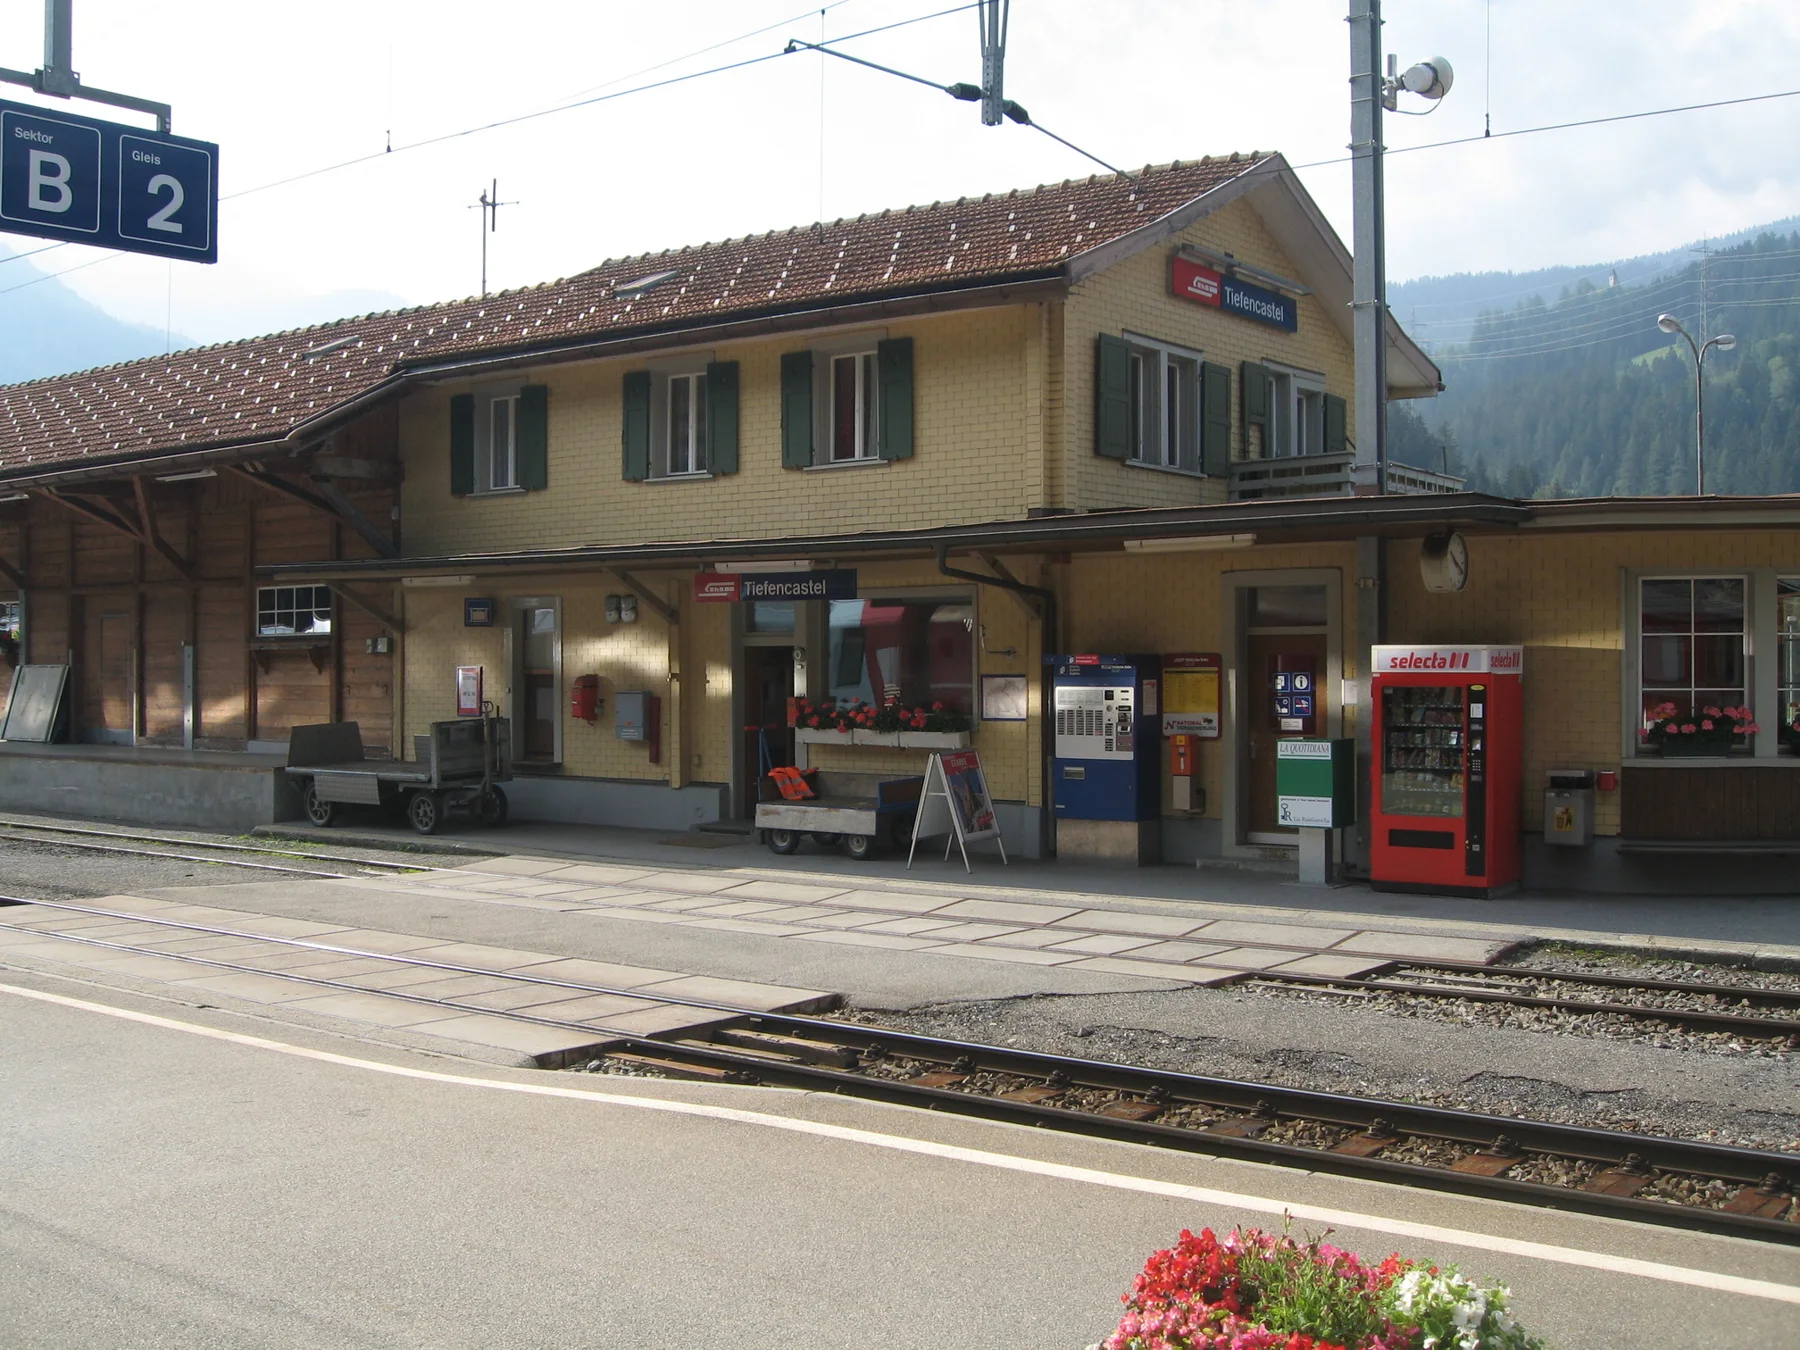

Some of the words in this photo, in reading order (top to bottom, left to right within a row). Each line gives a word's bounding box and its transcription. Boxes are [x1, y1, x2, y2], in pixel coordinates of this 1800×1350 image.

[14, 127, 54, 145] Sektor
[132, 150, 161, 165] Gleis
[28, 149, 73, 213] B
[147, 174, 184, 233] 2
[1224, 286, 1284, 322] Tiefencastel
[744, 579, 826, 596] Tiefencastel
[1389, 652, 1447, 669] selecta
[1490, 651, 1512, 668] selecta
